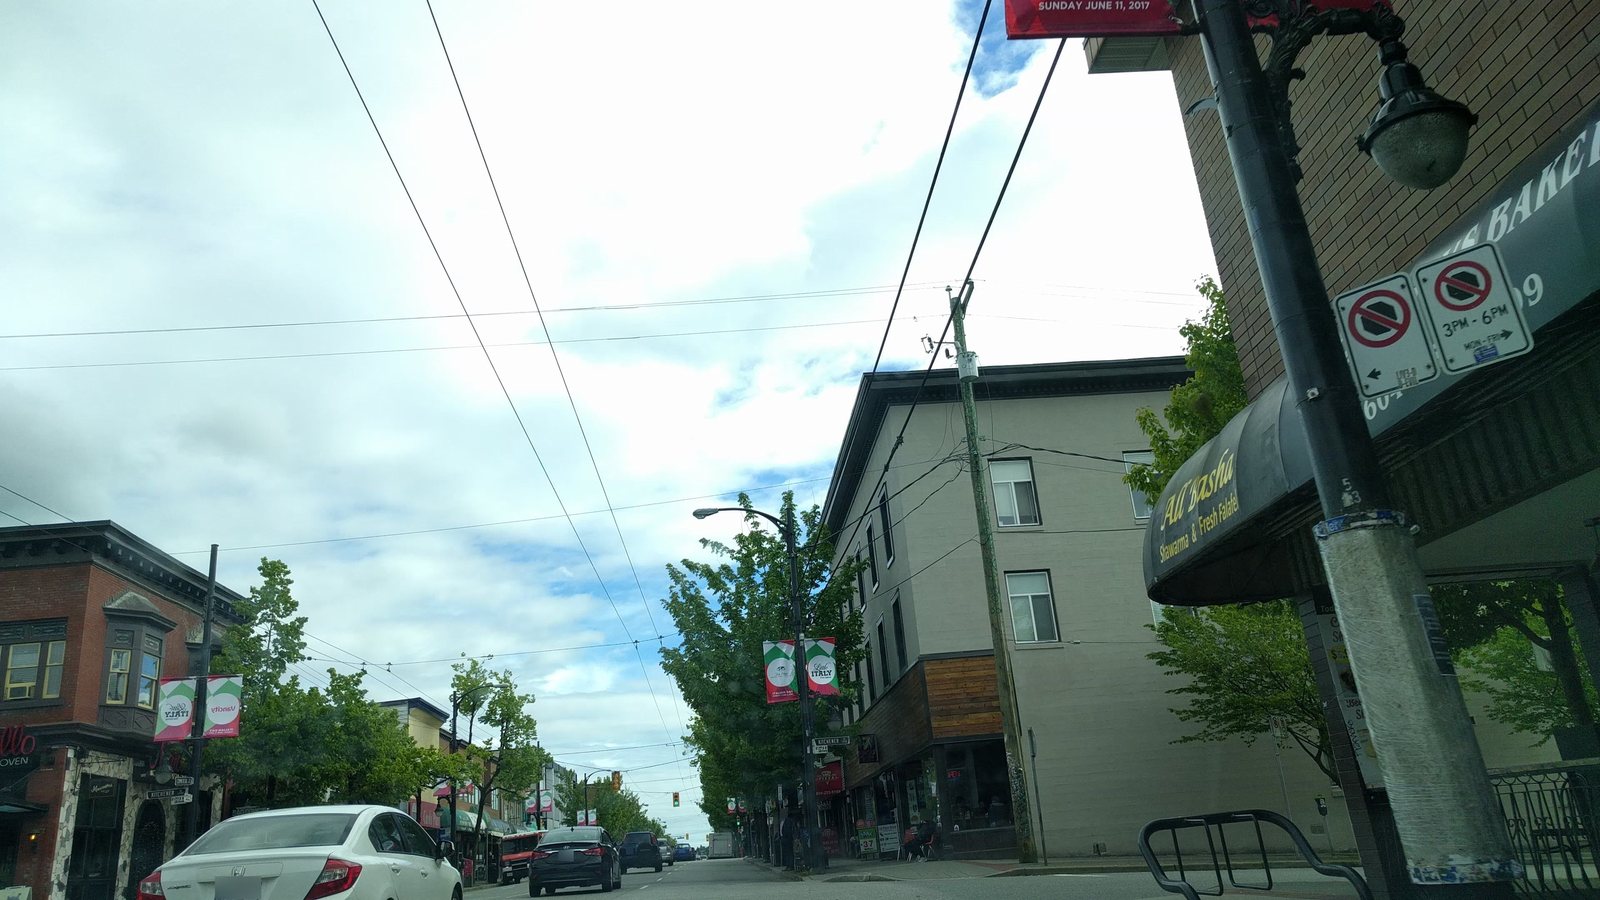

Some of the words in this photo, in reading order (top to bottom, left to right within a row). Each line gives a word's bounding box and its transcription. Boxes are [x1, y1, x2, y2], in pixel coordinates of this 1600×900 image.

[1038, 1, 1082, 11] SUNDAY
[1085, 1, 1112, 10] JUNE
[1114, 1, 1126, 12] 11,
[1128, 1, 1150, 10] 2017
[1442, 314, 1470, 339] 3PM
[1481, 302, 1509, 326] 6PM
[1160, 533, 1189, 563] Shawarma
[1199, 507, 1219, 536] Fresh
[1217, 492, 1239, 524] Falafel
[811, 670, 832, 678] ITALY
[0, 756, 29, 767] OVEN
